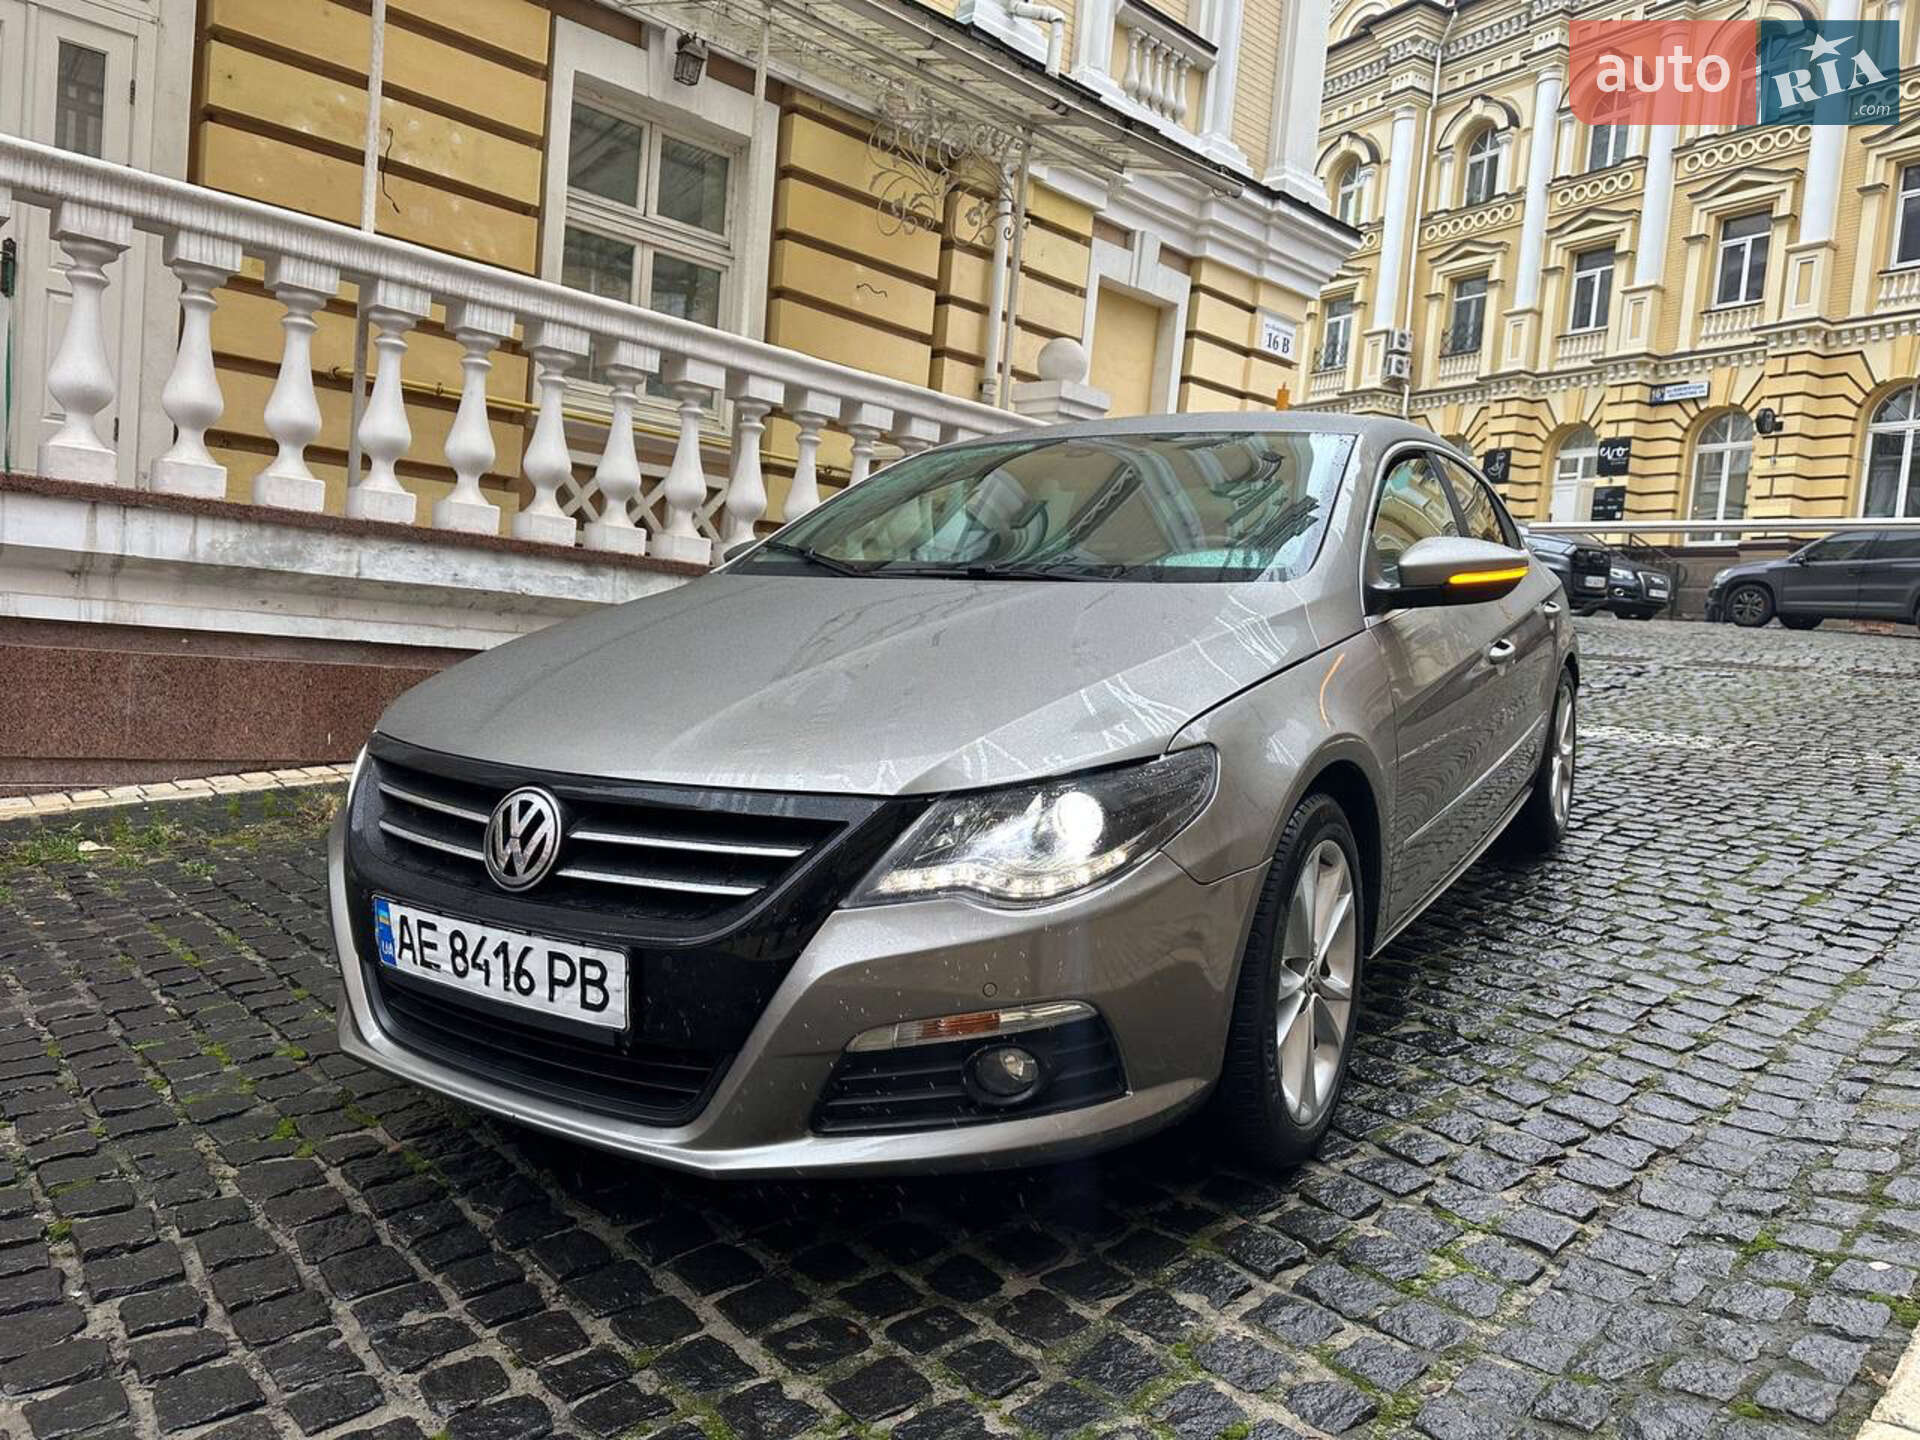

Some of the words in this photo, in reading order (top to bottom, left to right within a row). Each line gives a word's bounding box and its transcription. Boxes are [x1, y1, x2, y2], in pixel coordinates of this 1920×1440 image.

[1266, 332, 1279, 350] 16
[398, 915, 441, 971] AE
[449, 929, 536, 996] 8416
[547, 950, 610, 1012] PB
